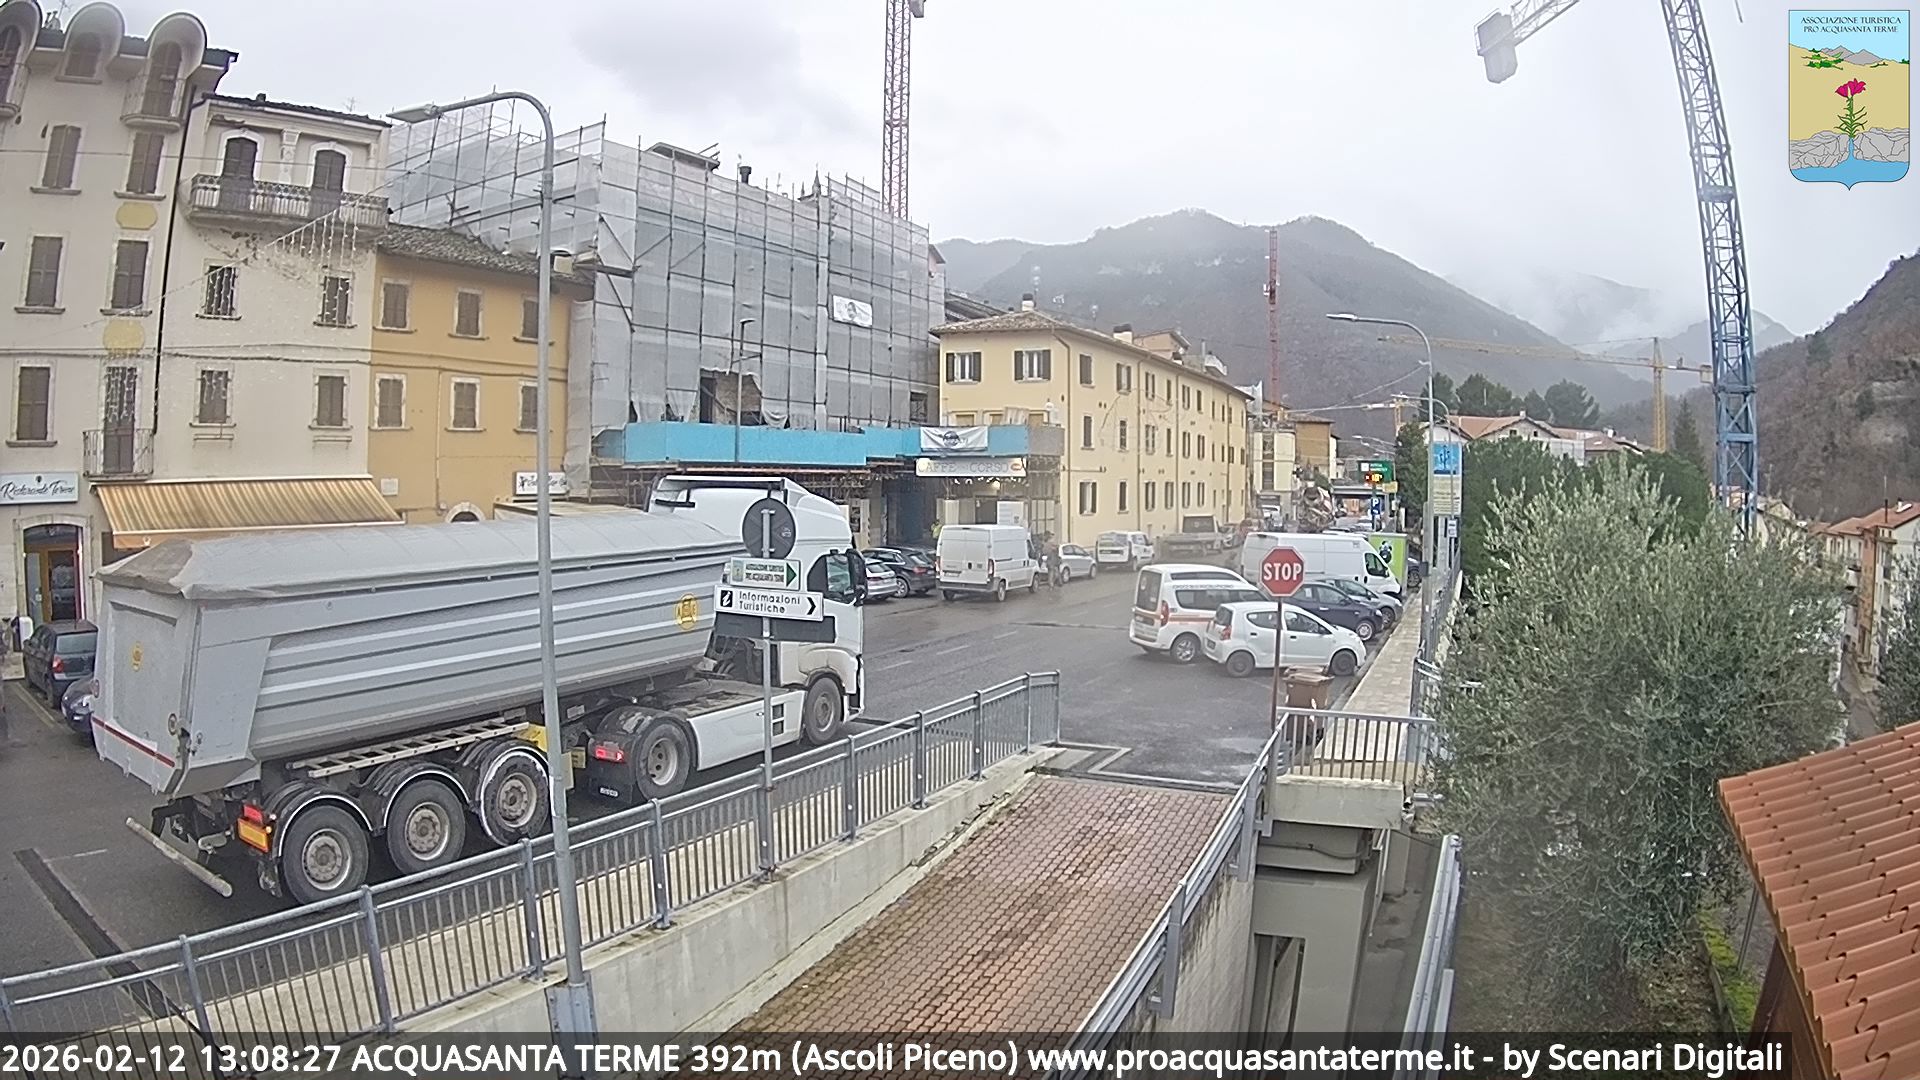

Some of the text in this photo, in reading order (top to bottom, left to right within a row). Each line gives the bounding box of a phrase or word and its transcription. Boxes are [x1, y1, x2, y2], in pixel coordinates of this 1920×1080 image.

[1372, 498, 1379, 507] P
[1263, 562, 1302, 581] STOP
[739, 590, 801, 605] Informazioni
[739, 600, 785, 614] Turistiche
